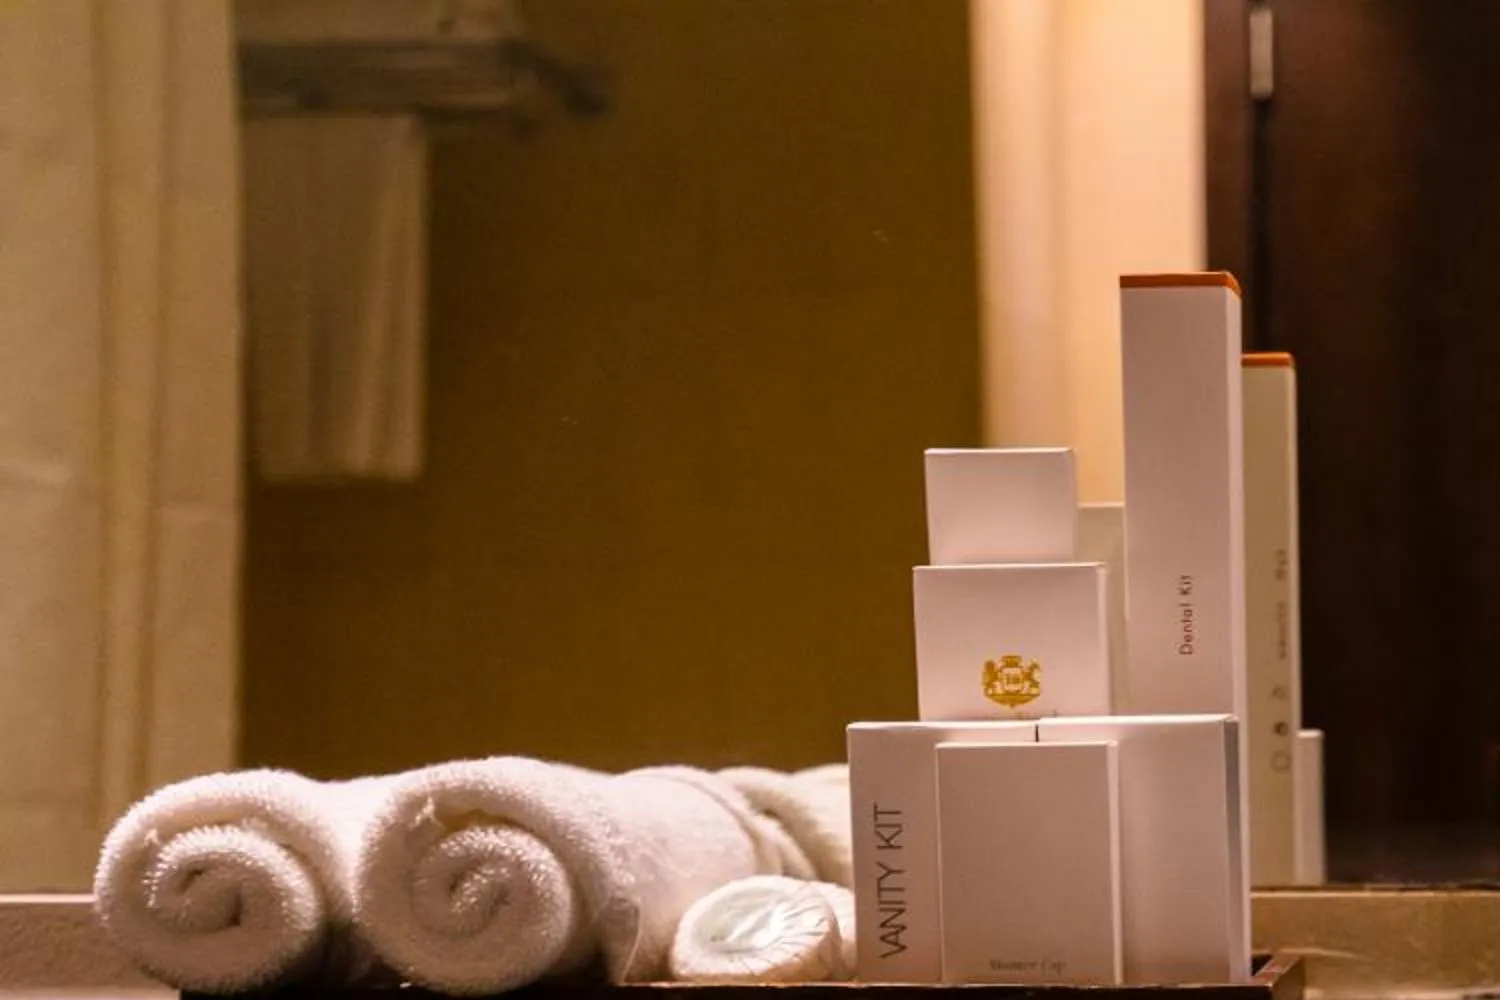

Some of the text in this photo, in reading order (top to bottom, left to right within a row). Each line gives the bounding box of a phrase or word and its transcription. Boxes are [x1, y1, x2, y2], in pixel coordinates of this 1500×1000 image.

[1177, 574, 1193, 656] Dental Kit
[873, 801, 908, 959] VANITY KIT
